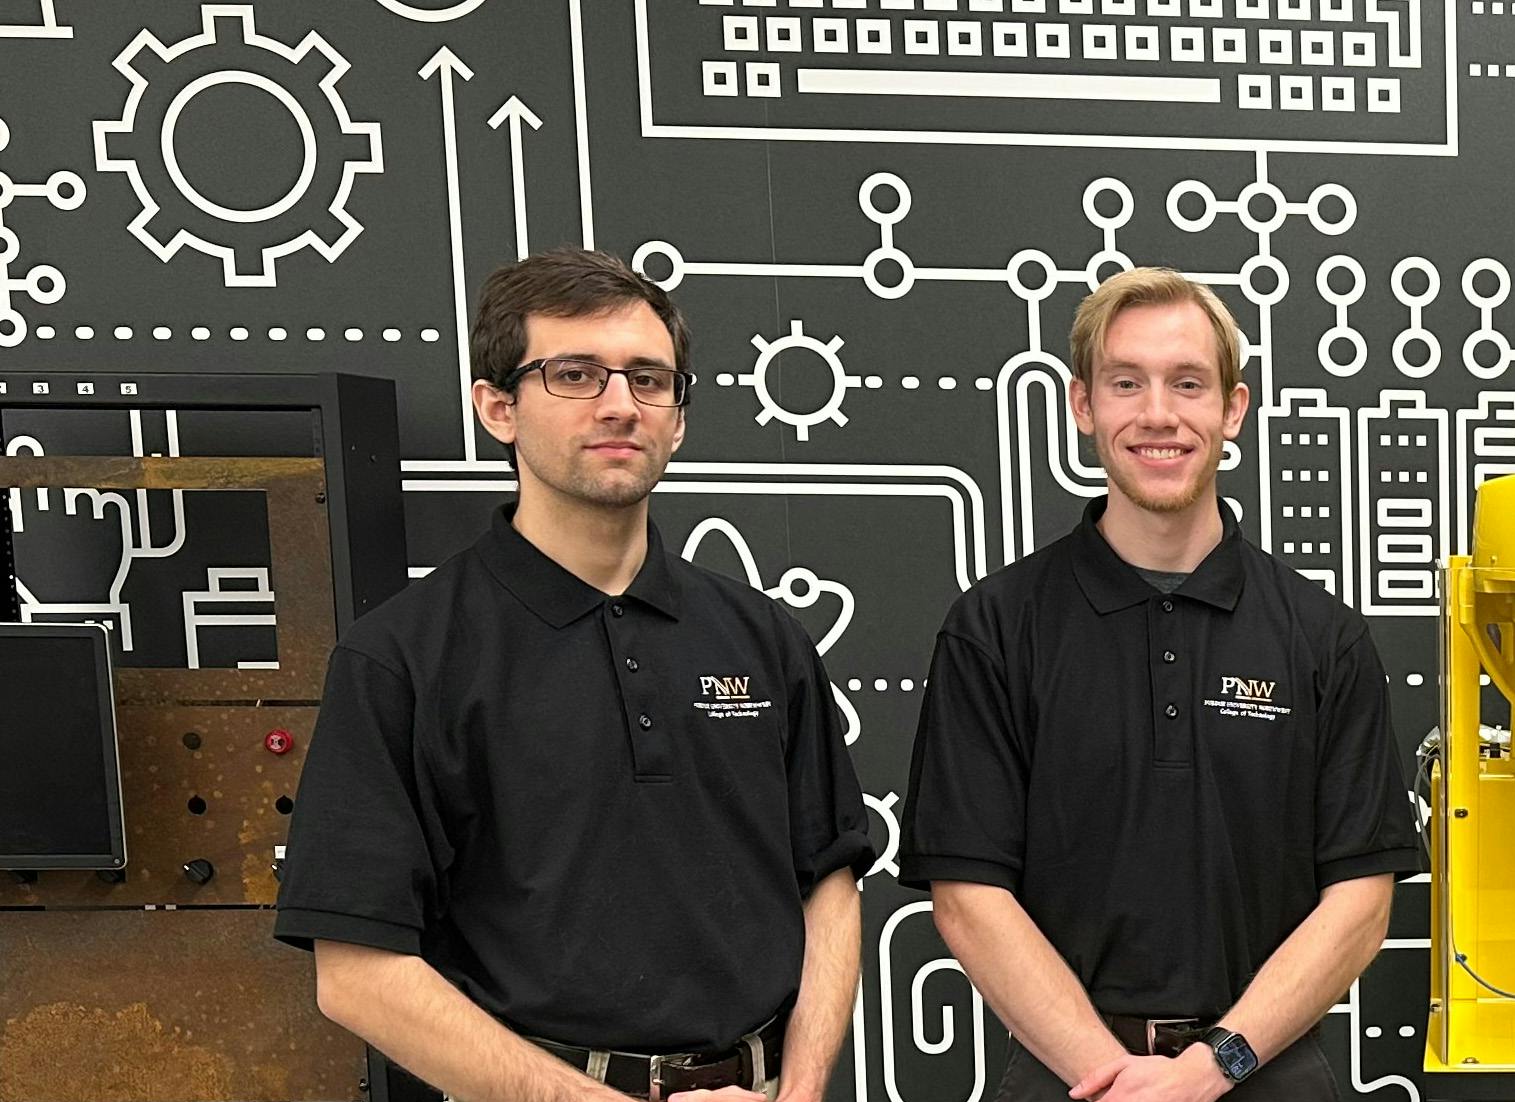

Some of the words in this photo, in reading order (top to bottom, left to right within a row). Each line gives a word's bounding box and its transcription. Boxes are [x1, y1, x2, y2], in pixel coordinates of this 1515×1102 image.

[37, 384, 45, 393] 3
[81, 385, 89, 393] 4
[125, 385, 132, 394] 5
[699, 676, 750, 695] PNW
[1220, 676, 1276, 698] PNW
